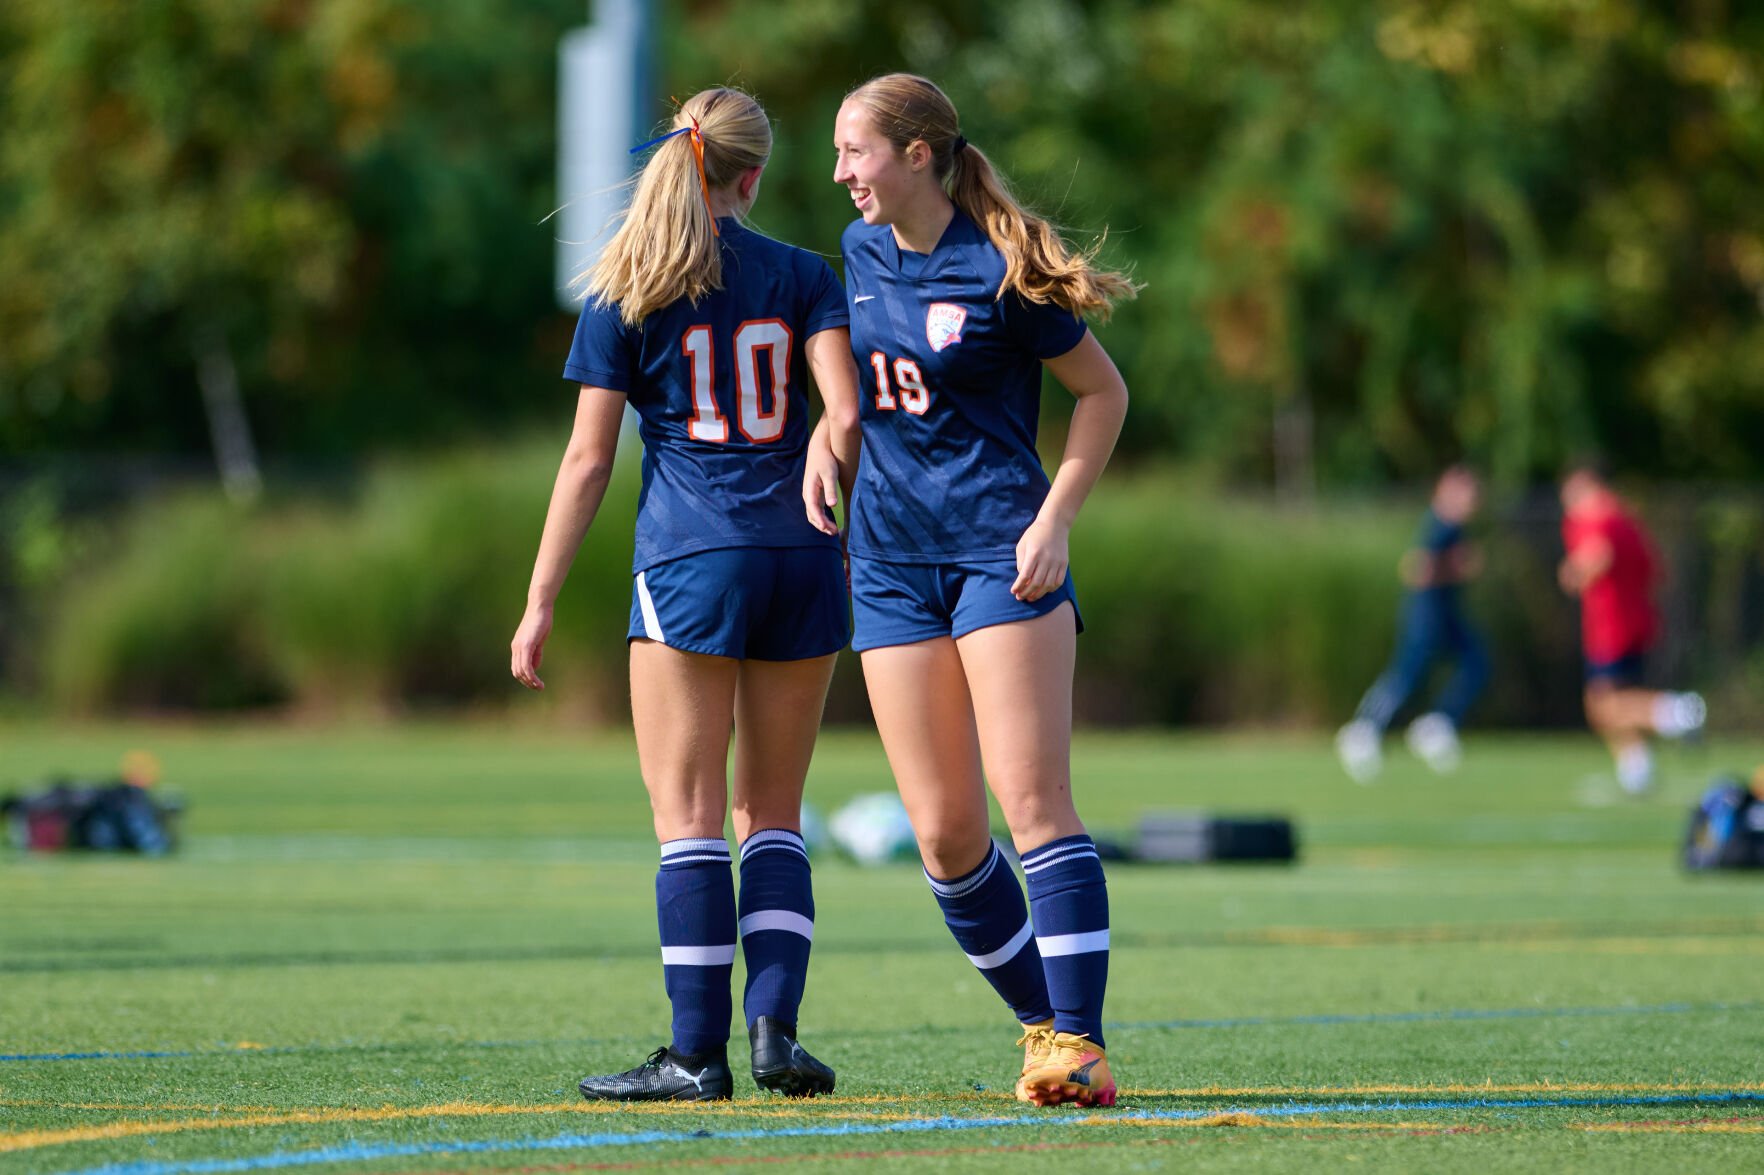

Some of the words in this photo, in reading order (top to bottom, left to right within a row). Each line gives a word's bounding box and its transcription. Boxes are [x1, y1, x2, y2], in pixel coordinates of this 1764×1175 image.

[932, 308, 961, 322] AMSA
[682, 318, 794, 444] 10
[870, 351, 930, 415] 19
